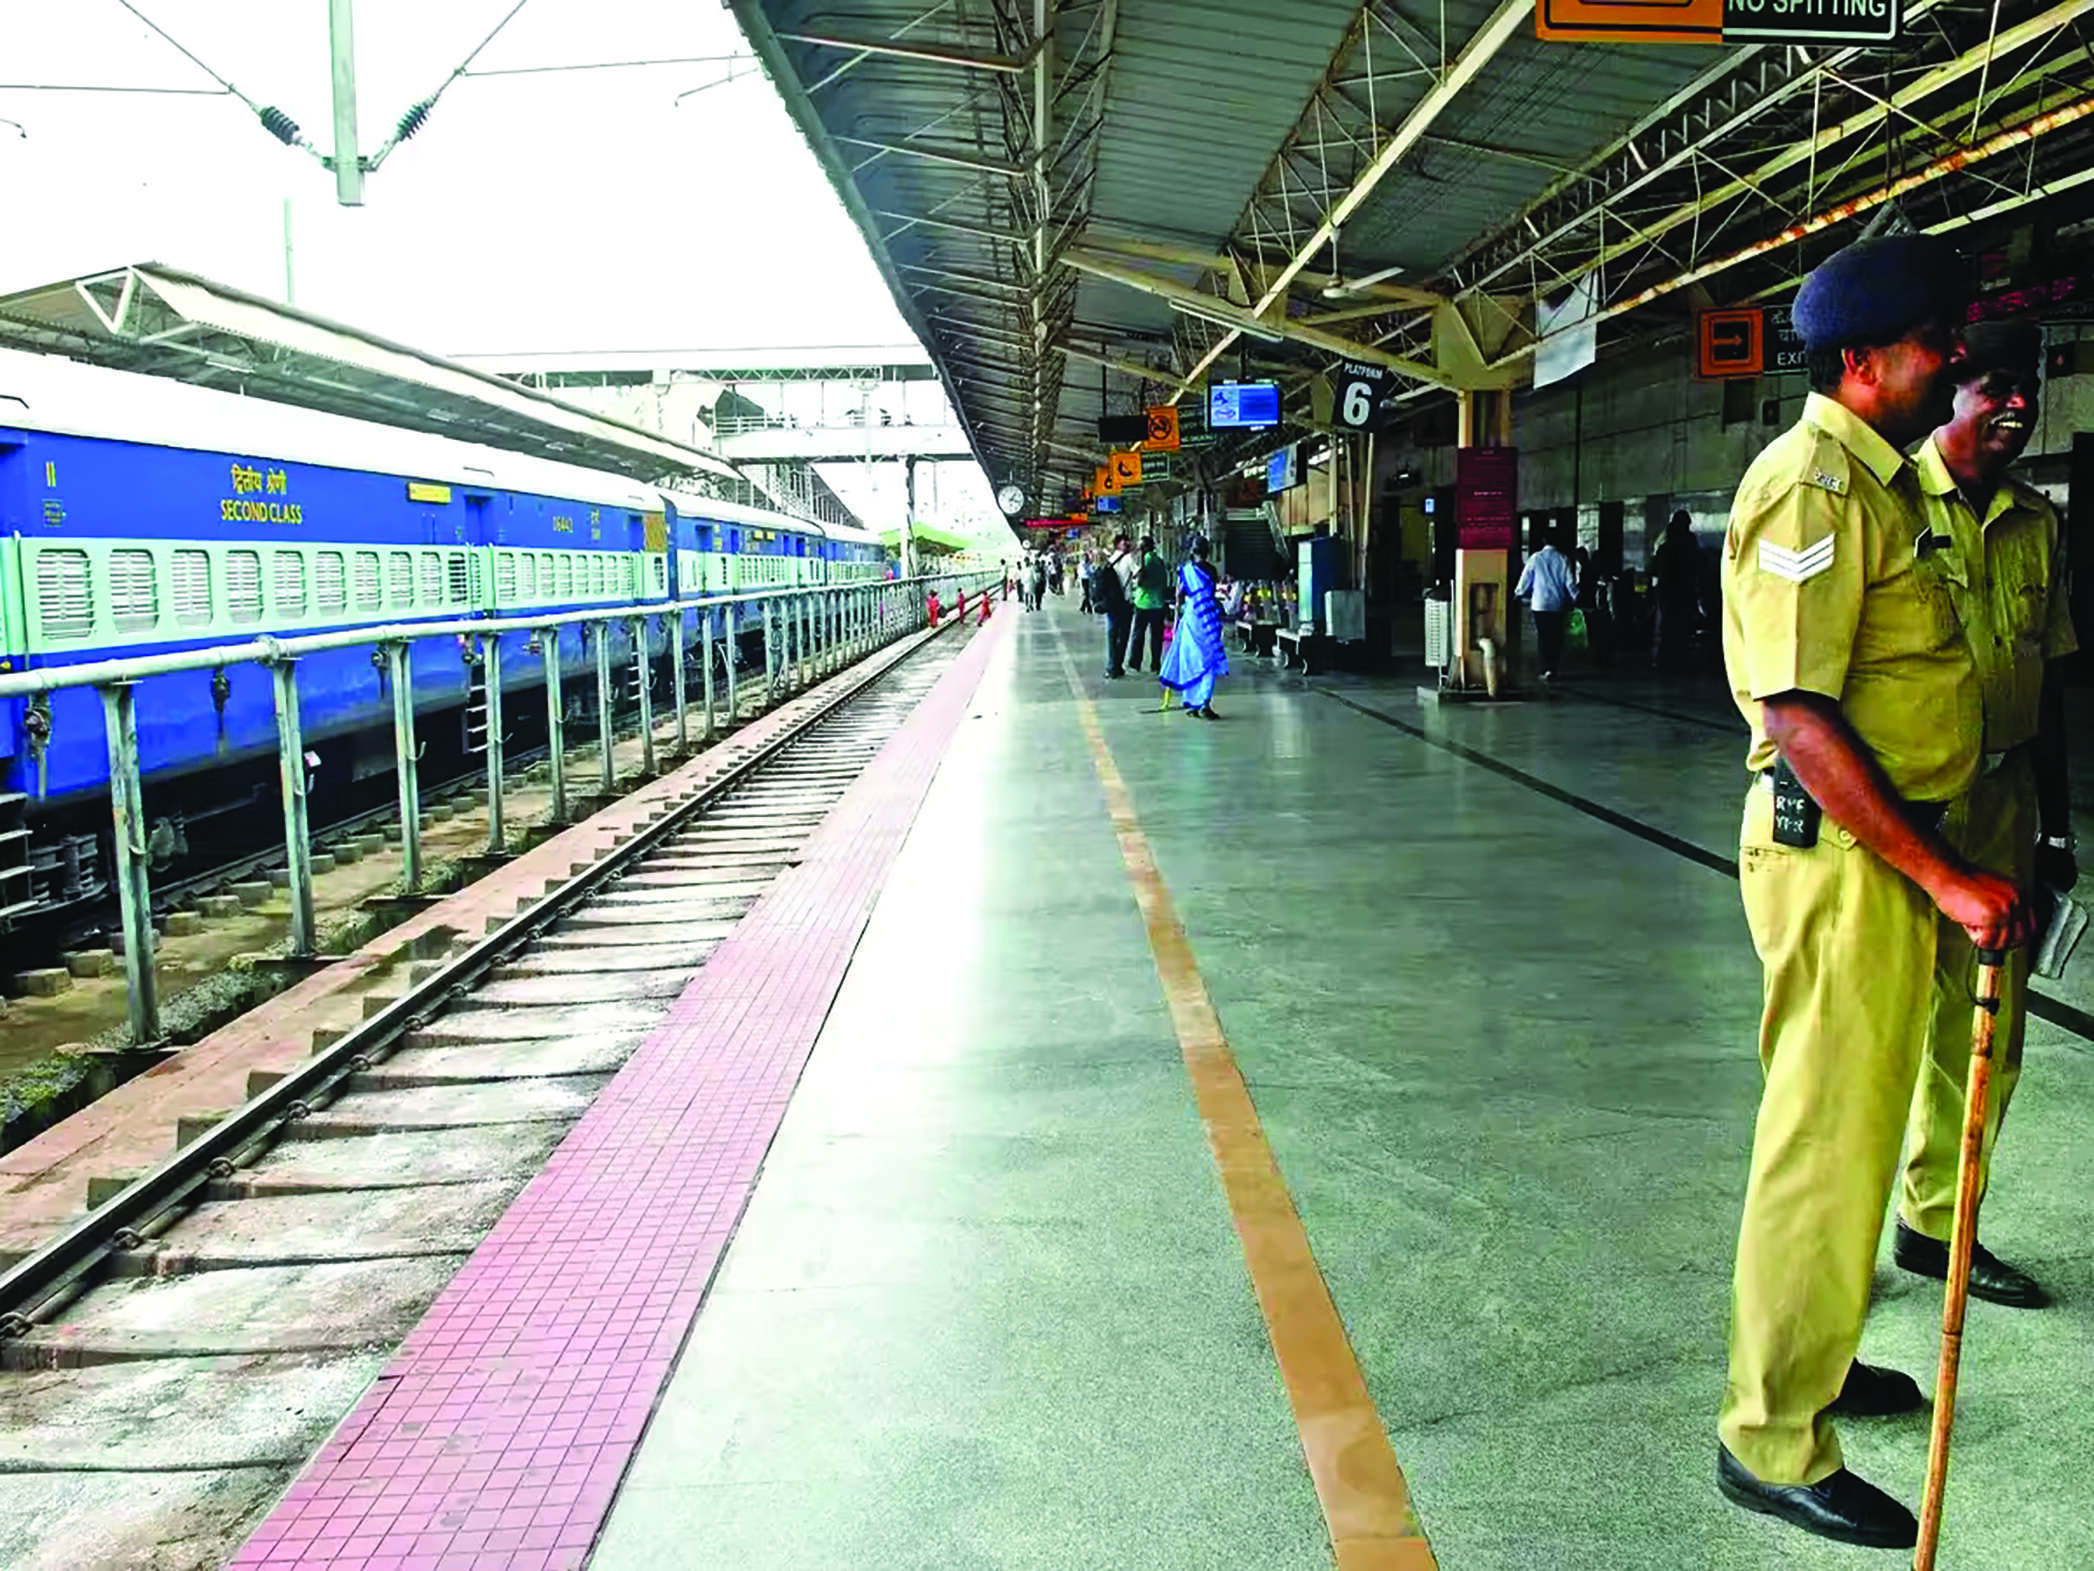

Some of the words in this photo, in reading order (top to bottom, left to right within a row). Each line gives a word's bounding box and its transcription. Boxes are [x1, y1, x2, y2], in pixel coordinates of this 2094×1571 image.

[1728, 0, 1765, 13] NO
[1773, 0, 1886, 17] SPITTING
[1344, 362, 1383, 379] PLATFORM
[1343, 381, 1372, 426] 6
[221, 499, 268, 522] SECOND
[269, 502, 303, 524] CLASS
